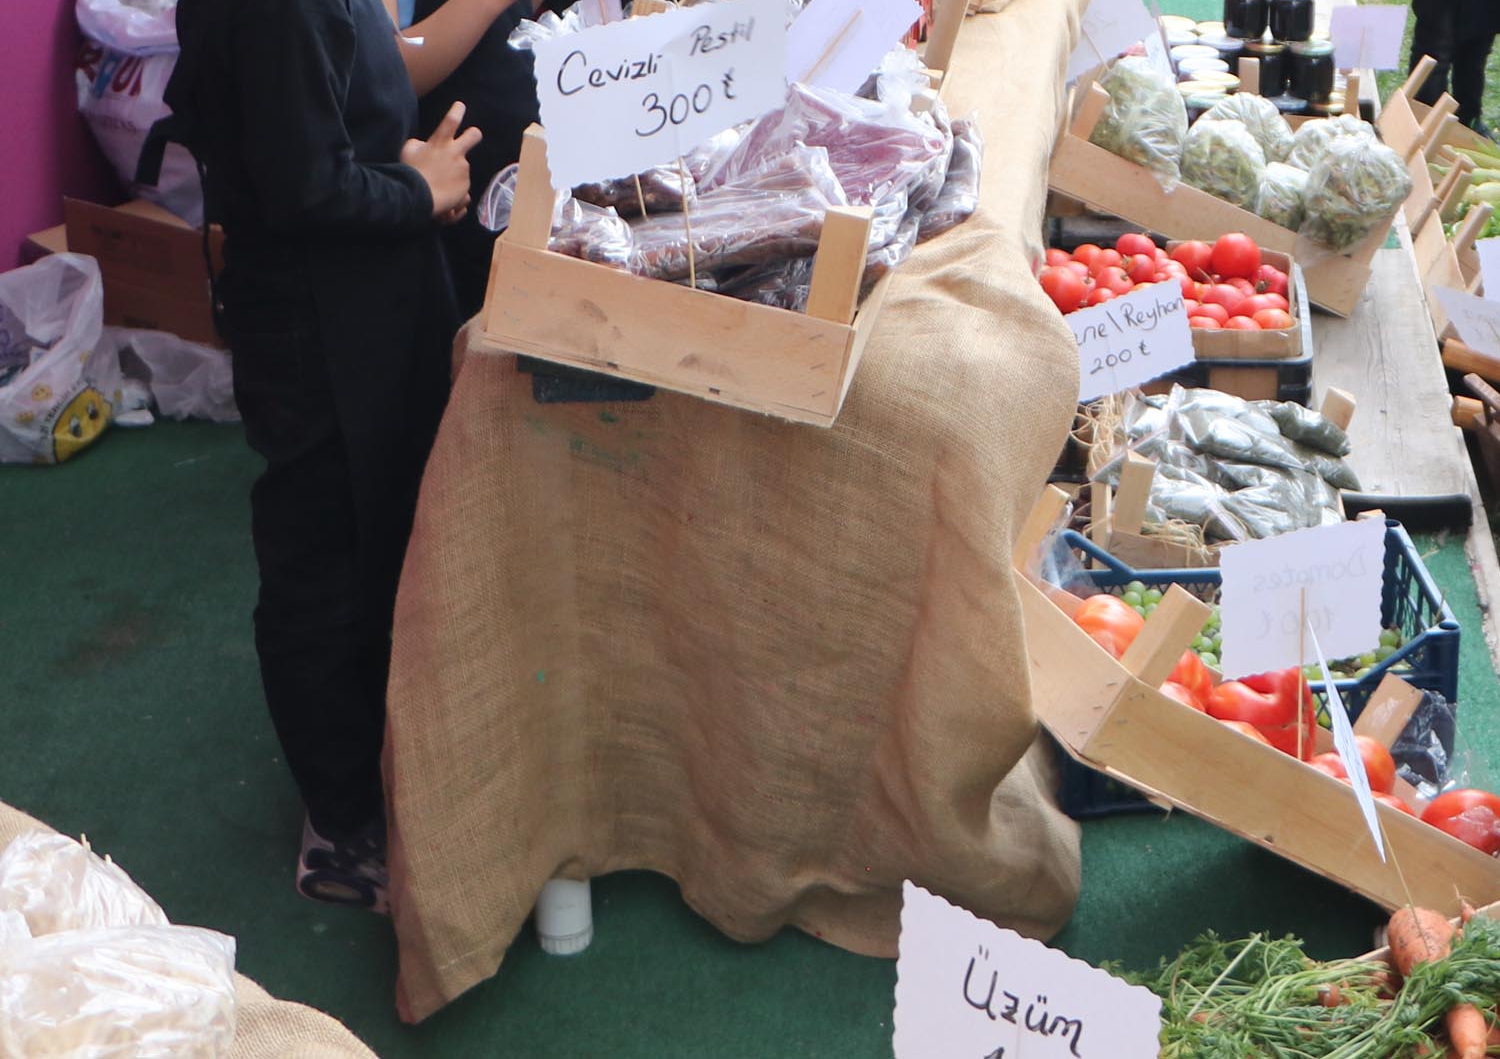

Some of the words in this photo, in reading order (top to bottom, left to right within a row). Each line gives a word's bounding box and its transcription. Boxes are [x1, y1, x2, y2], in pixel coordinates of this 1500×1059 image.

[556, 50, 663, 96] Cevizli
[689, 16, 755, 57] Pestil
[963, 944, 1083, 1059] Üzüm
